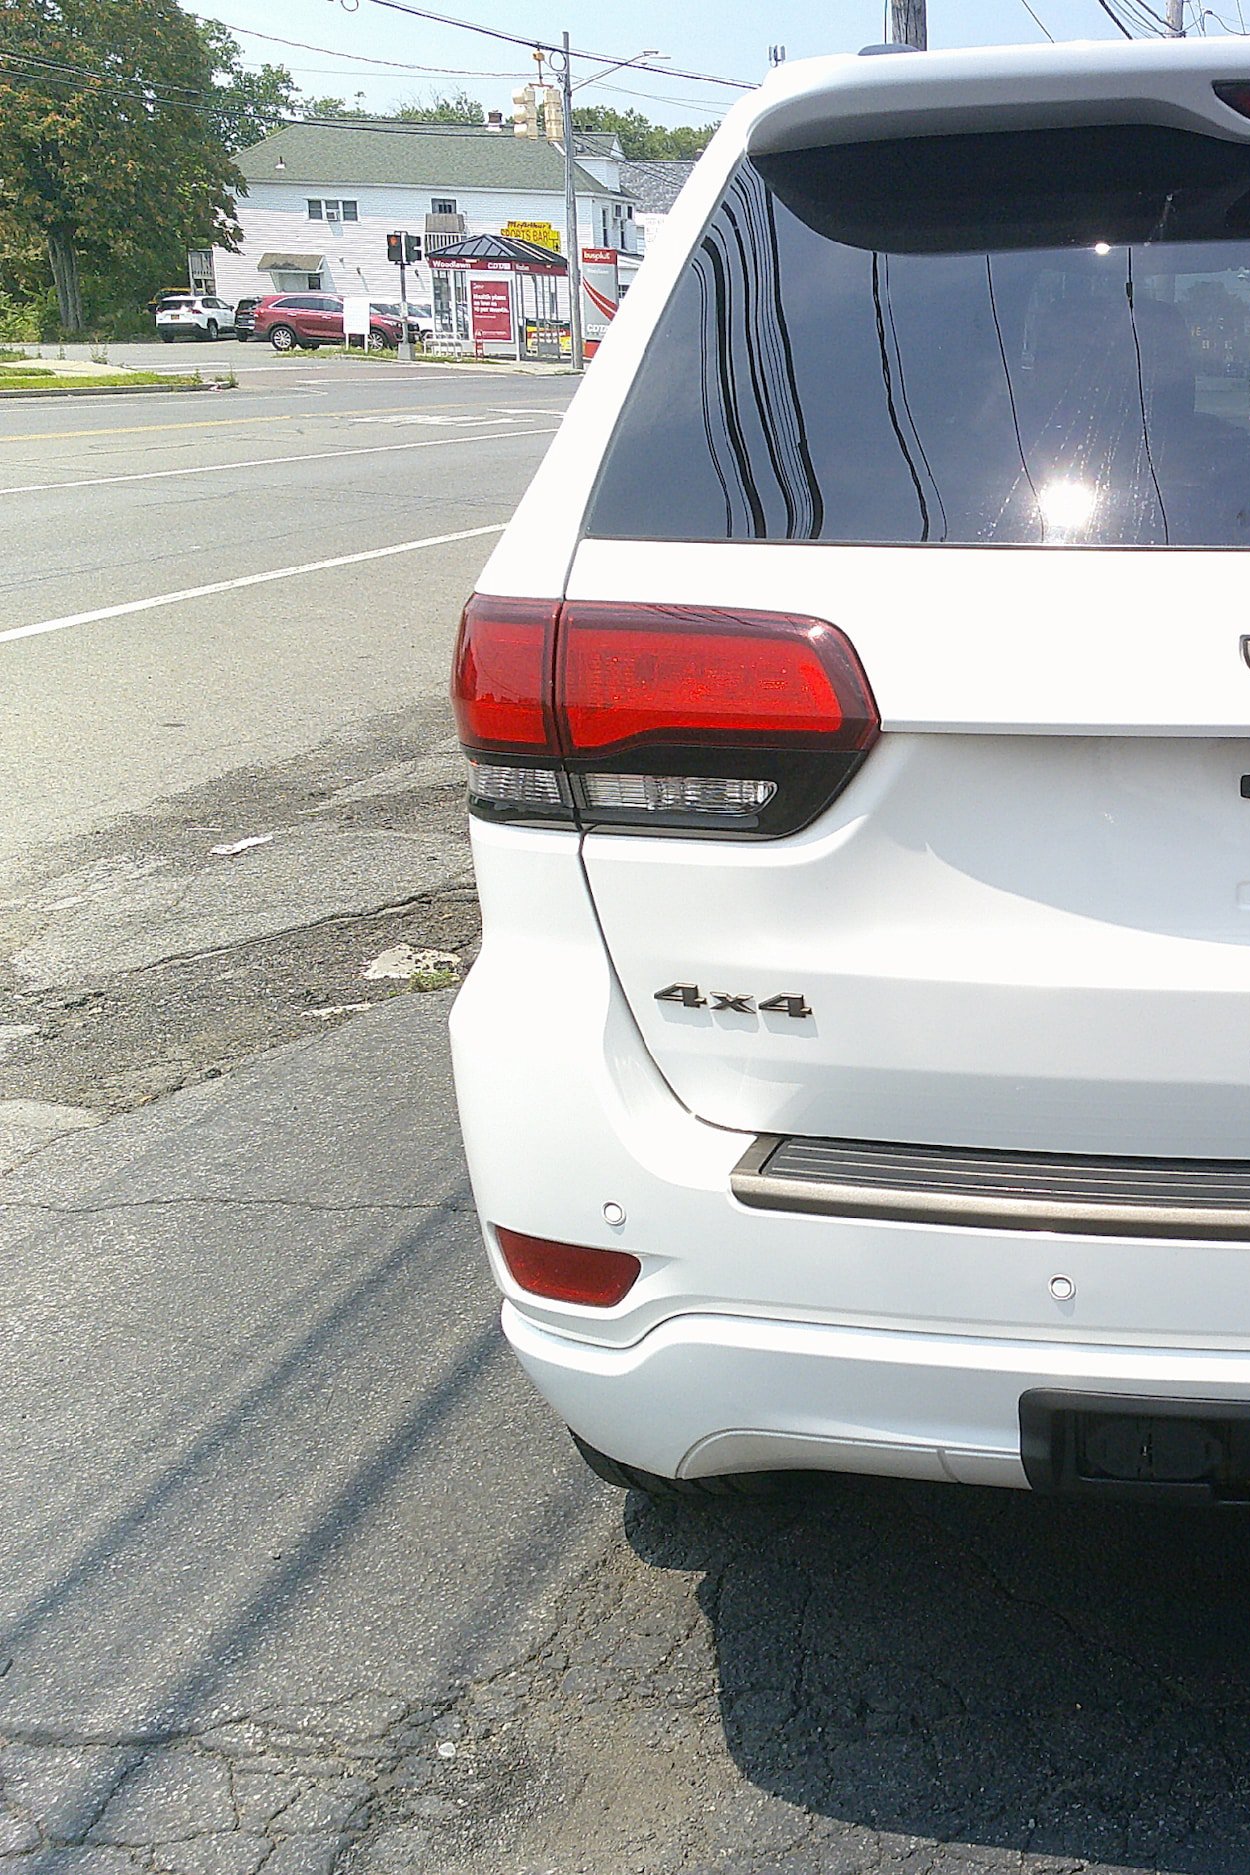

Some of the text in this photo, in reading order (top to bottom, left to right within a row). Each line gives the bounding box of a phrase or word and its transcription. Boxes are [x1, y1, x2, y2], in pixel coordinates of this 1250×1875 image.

[500, 229, 548, 242] SPORTS BAR
[432, 260, 471, 269] Woodlawn
[586, 323, 608, 332] CDT
[654, 982, 813, 1018] 4x4
